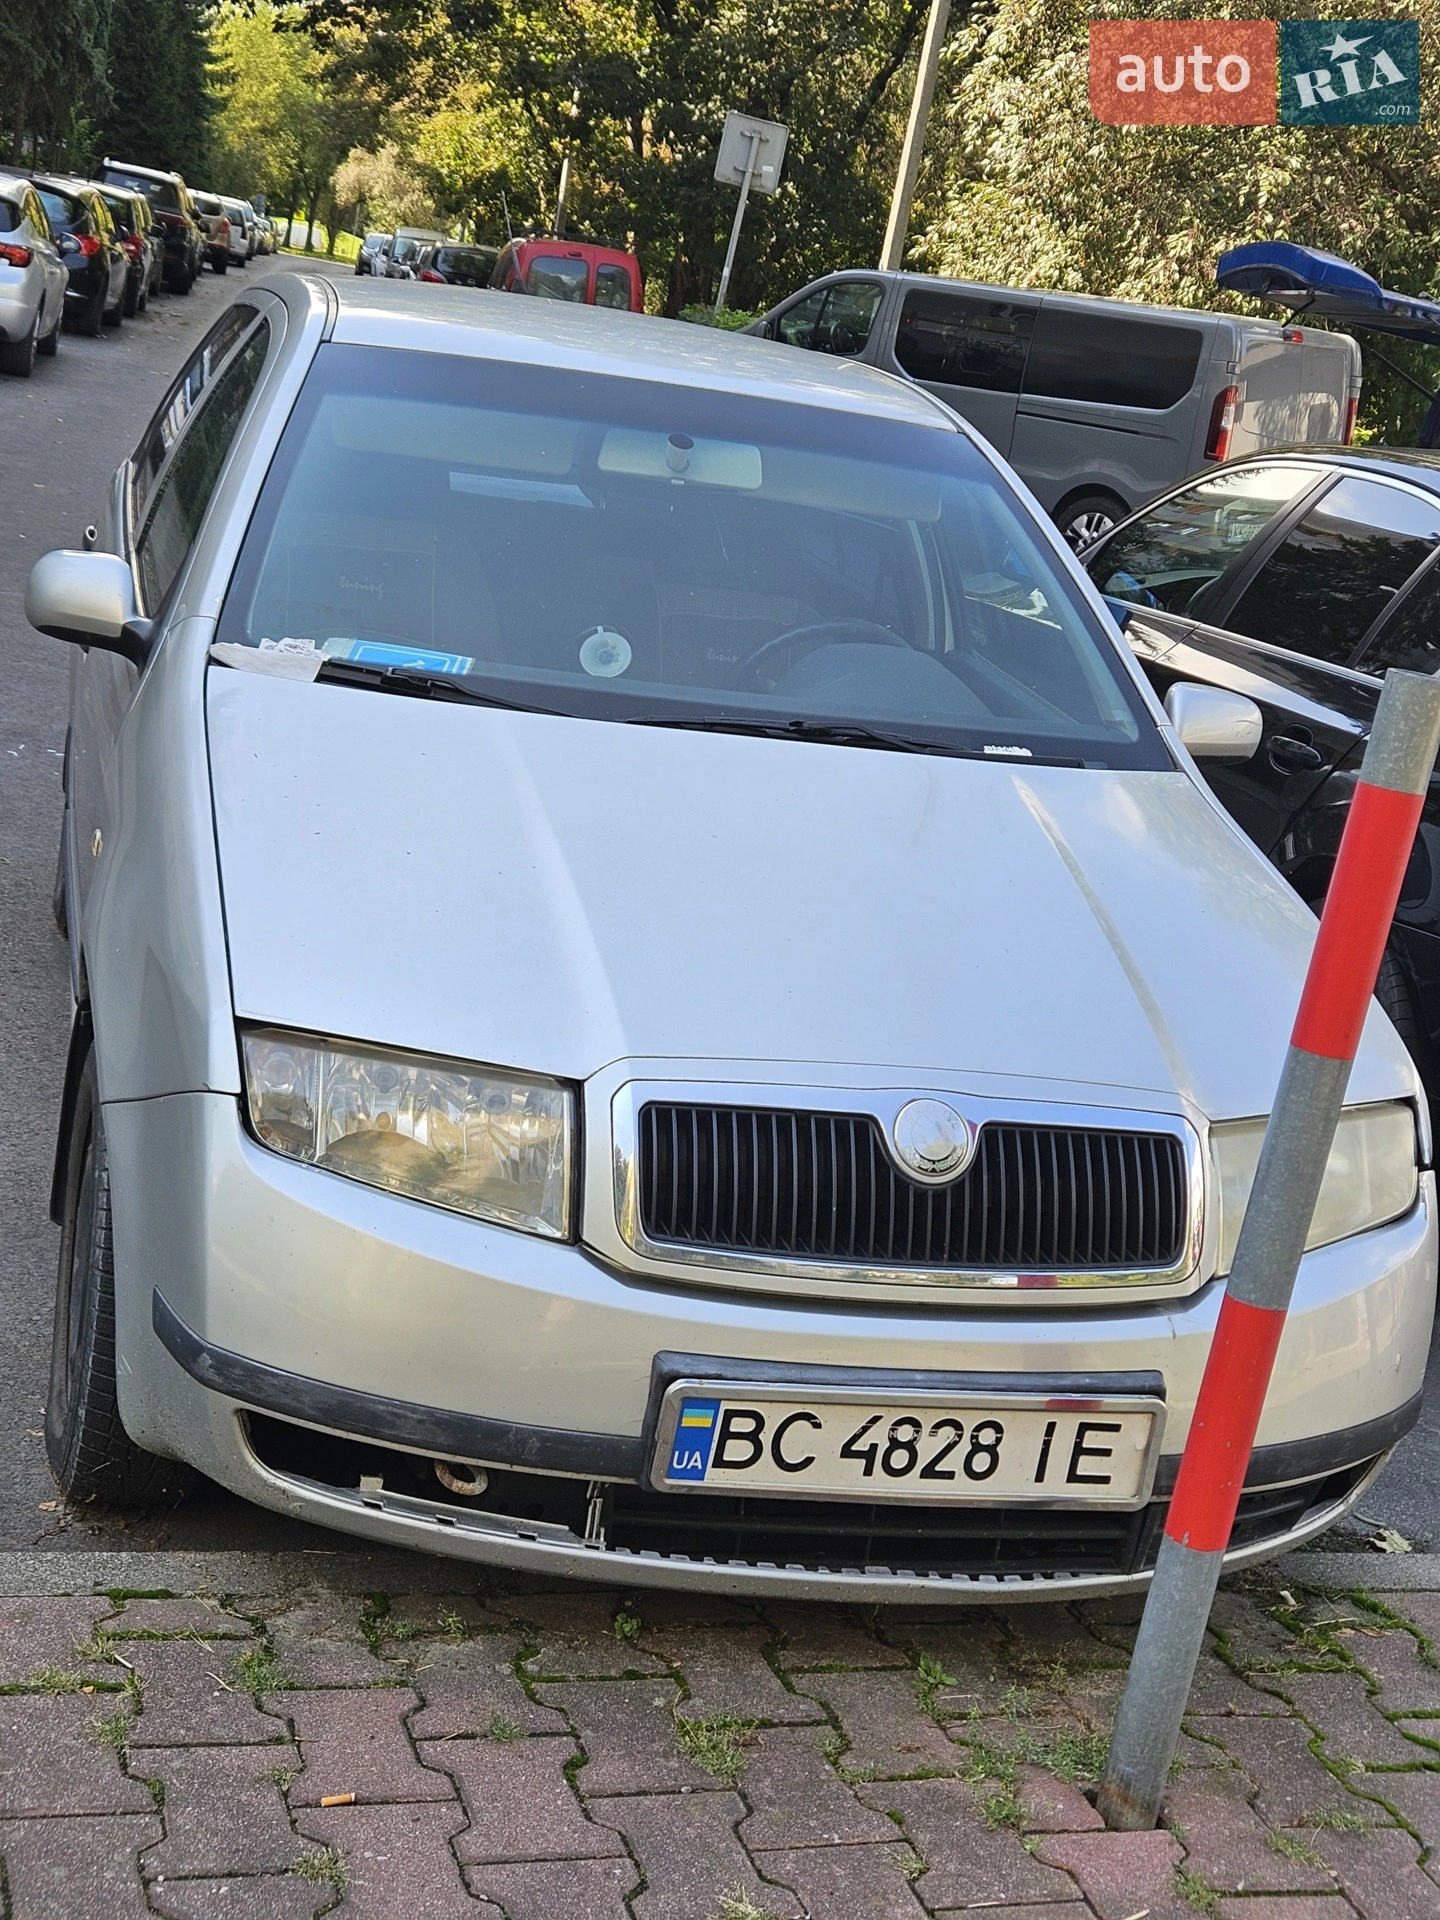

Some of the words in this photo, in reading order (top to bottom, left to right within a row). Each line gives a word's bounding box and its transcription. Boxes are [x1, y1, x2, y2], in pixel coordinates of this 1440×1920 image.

[672, 1450, 703, 1470] UA
[711, 1408, 823, 1473] BC
[839, 1414, 1005, 1482] 4828
[1034, 1420, 1123, 1485] IE
